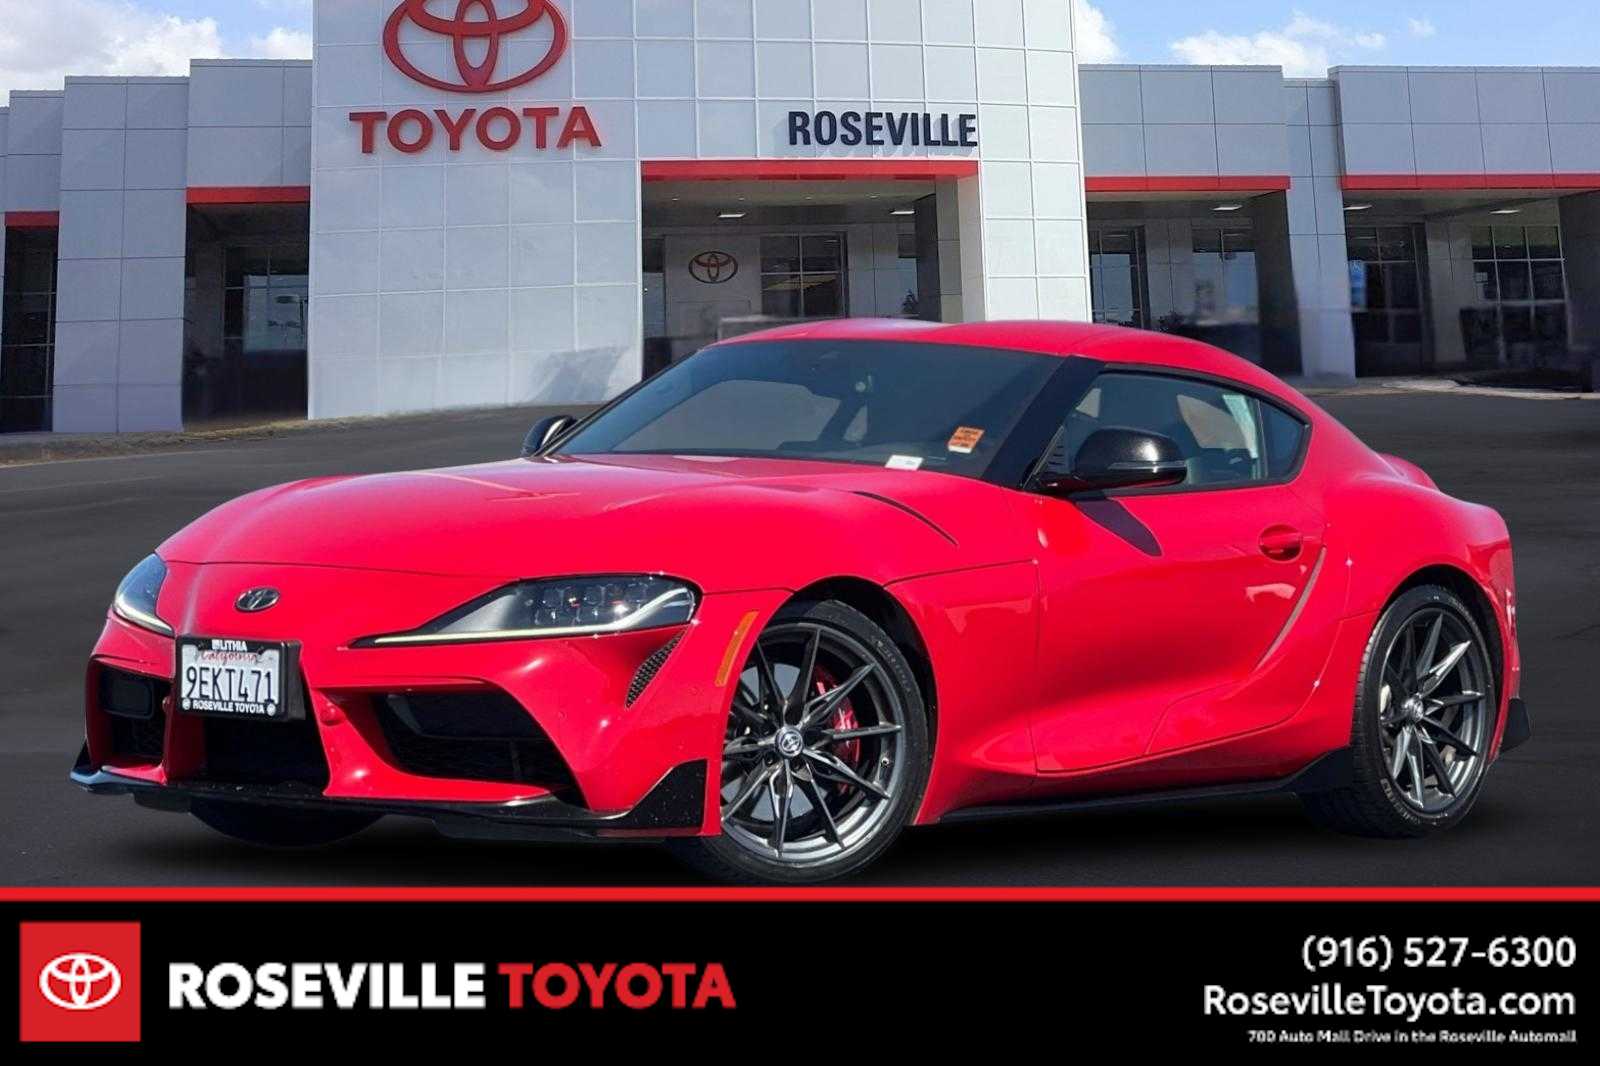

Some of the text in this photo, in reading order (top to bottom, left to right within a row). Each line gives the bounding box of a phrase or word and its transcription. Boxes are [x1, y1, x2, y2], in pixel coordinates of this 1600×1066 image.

[349, 106, 602, 154] TOYOTA
[788, 111, 978, 147] ROSEVILLE
[220, 639, 248, 651] LITHIA
[186, 666, 274, 703] 9EKT471
[192, 700, 265, 714] ROSEVILLE TOYOTA
